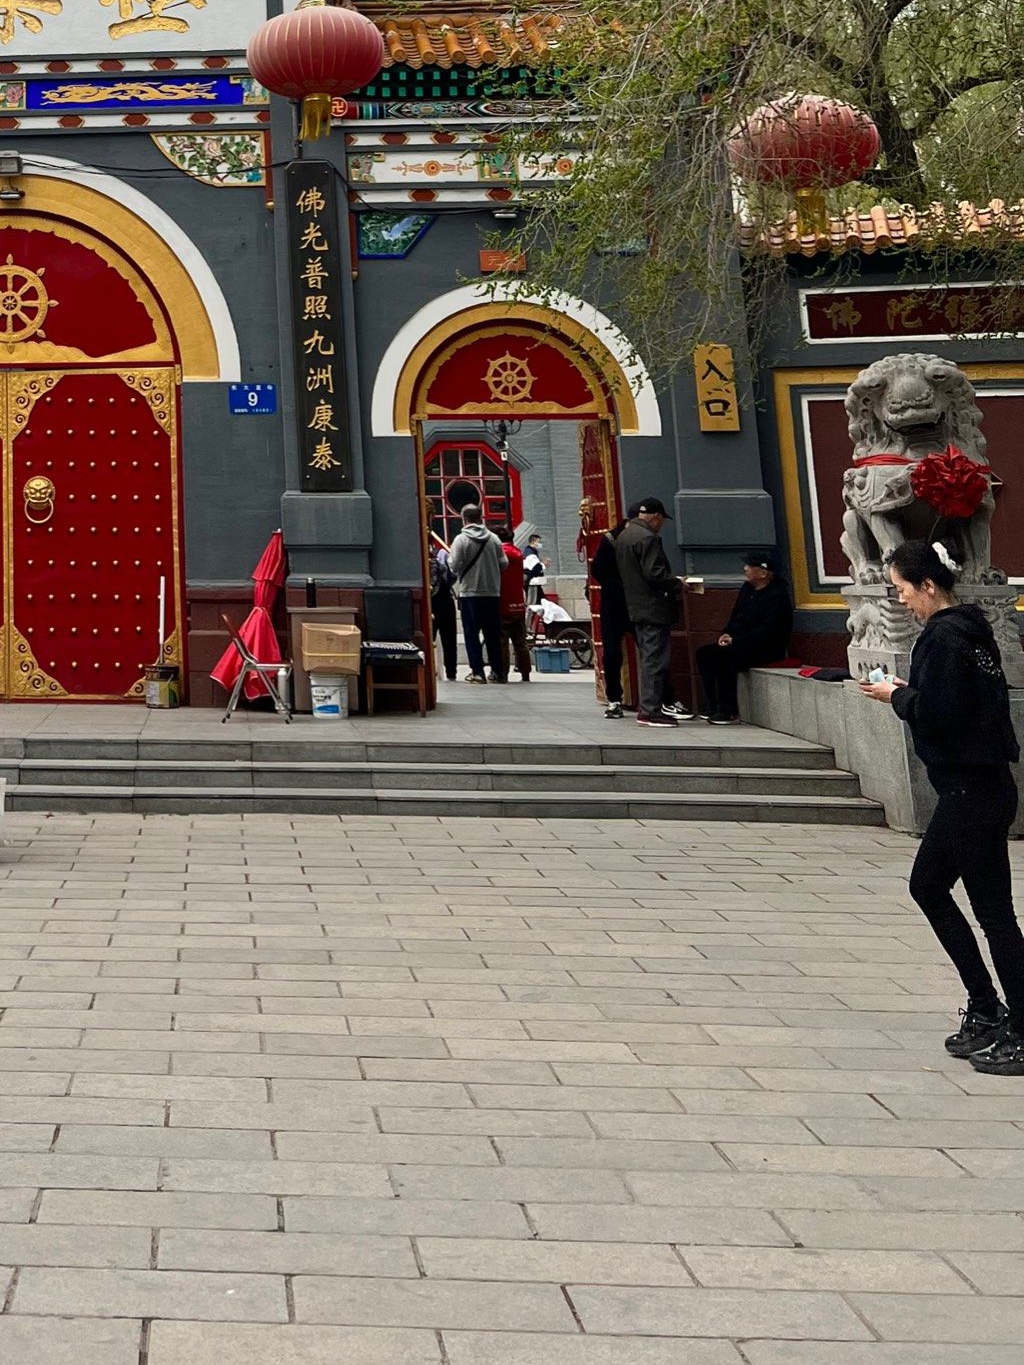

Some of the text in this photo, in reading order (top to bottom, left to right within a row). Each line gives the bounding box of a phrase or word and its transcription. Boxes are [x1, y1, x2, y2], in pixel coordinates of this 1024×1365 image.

[296, 186, 342, 471] 佛光普照九洲康泰
[248, 392, 258, 406] 9
[701, 359, 730, 416] 入口
